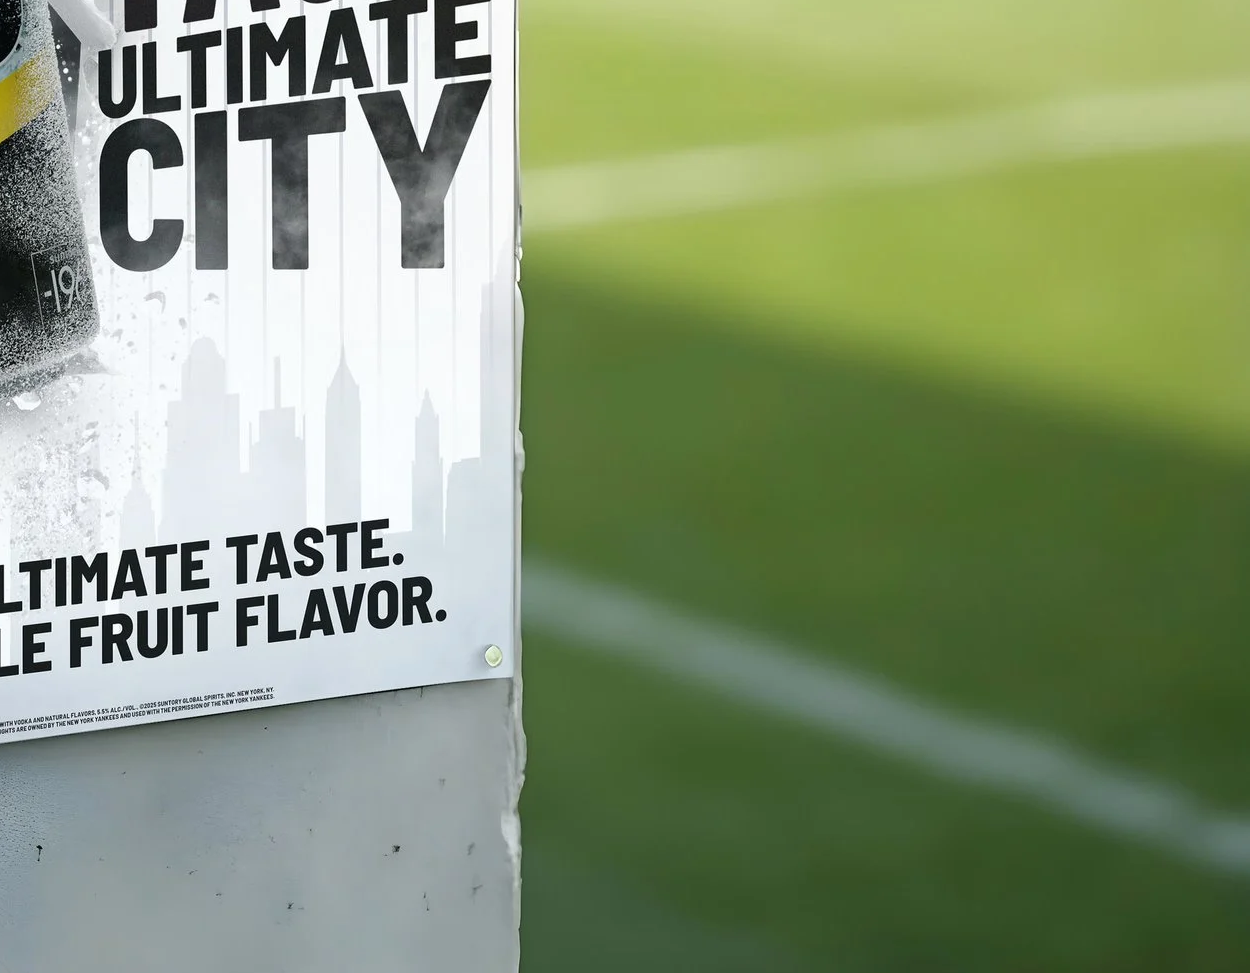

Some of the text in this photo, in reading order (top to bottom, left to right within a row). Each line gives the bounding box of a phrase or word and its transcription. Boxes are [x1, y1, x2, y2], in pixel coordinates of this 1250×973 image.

[99, 78, 492, 272] CITY
[226, 518, 405, 584] TASTE.
[68, 601, 219, 669] FRUIT
[235, 575, 448, 648] FLAVOR.
[14, 718, 32, 726] VODKA
[45, 713, 70, 722] NATURAL
[158, 698, 182, 707] SUNTORY
[183, 696, 203, 704] GLOBAL
[28, 723, 47, 731] OWNED
[95, 714, 119, 722] YANKEES
[172, 702, 203, 712] PERMISSION
[249, 694, 275, 702] YANKEES.
